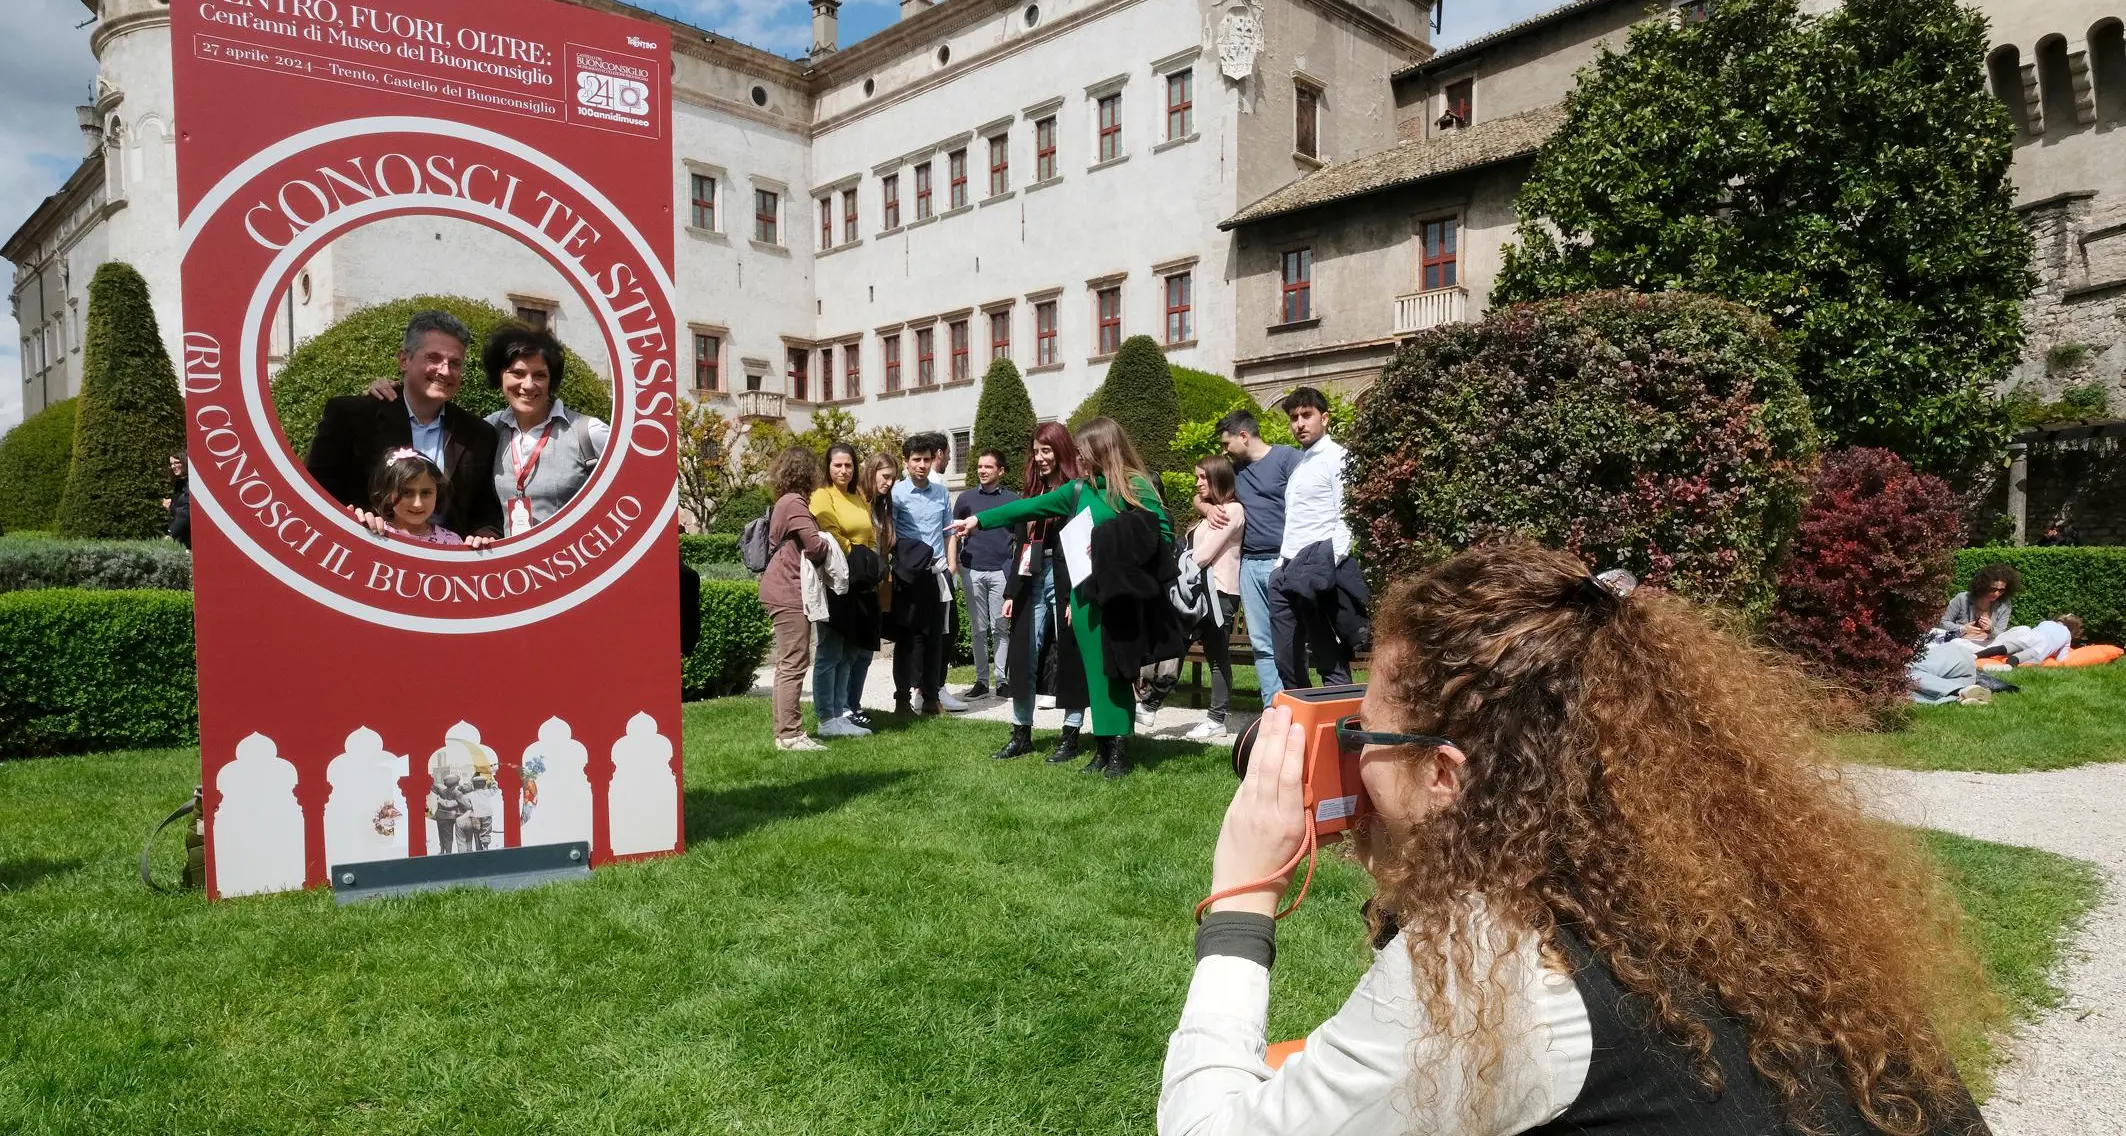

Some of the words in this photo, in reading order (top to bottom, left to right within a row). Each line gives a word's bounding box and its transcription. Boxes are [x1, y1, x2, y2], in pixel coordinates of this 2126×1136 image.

[303, 24, 321, 42] di
[328, 27, 391, 55] Museo
[396, 42, 424, 61] del
[430, 47, 553, 85] Buonconsiglio
[351, 5, 451, 49] FUORI,
[457, 28, 552, 66] OLTRE:
[202, 42, 220, 56] 27
[226, 47, 269, 63] aprile
[383, 73, 438, 93] Castello
[442, 84, 462, 98] del
[467, 88, 556, 114] Buonconsiglio
[576, 56, 649, 78] BUONCONSIGLIO
[577, 106, 650, 127] 100annidimuseo
[244, 152, 526, 250] CONOSCI
[535, 190, 601, 262] TE
[594, 262, 675, 457] STESSO
[184, 331, 222, 394] (RI)
[196, 404, 321, 557] CONOSCI
[319, 547, 356, 581] IL
[365, 494, 642, 603] BUONCONSIGLIO
